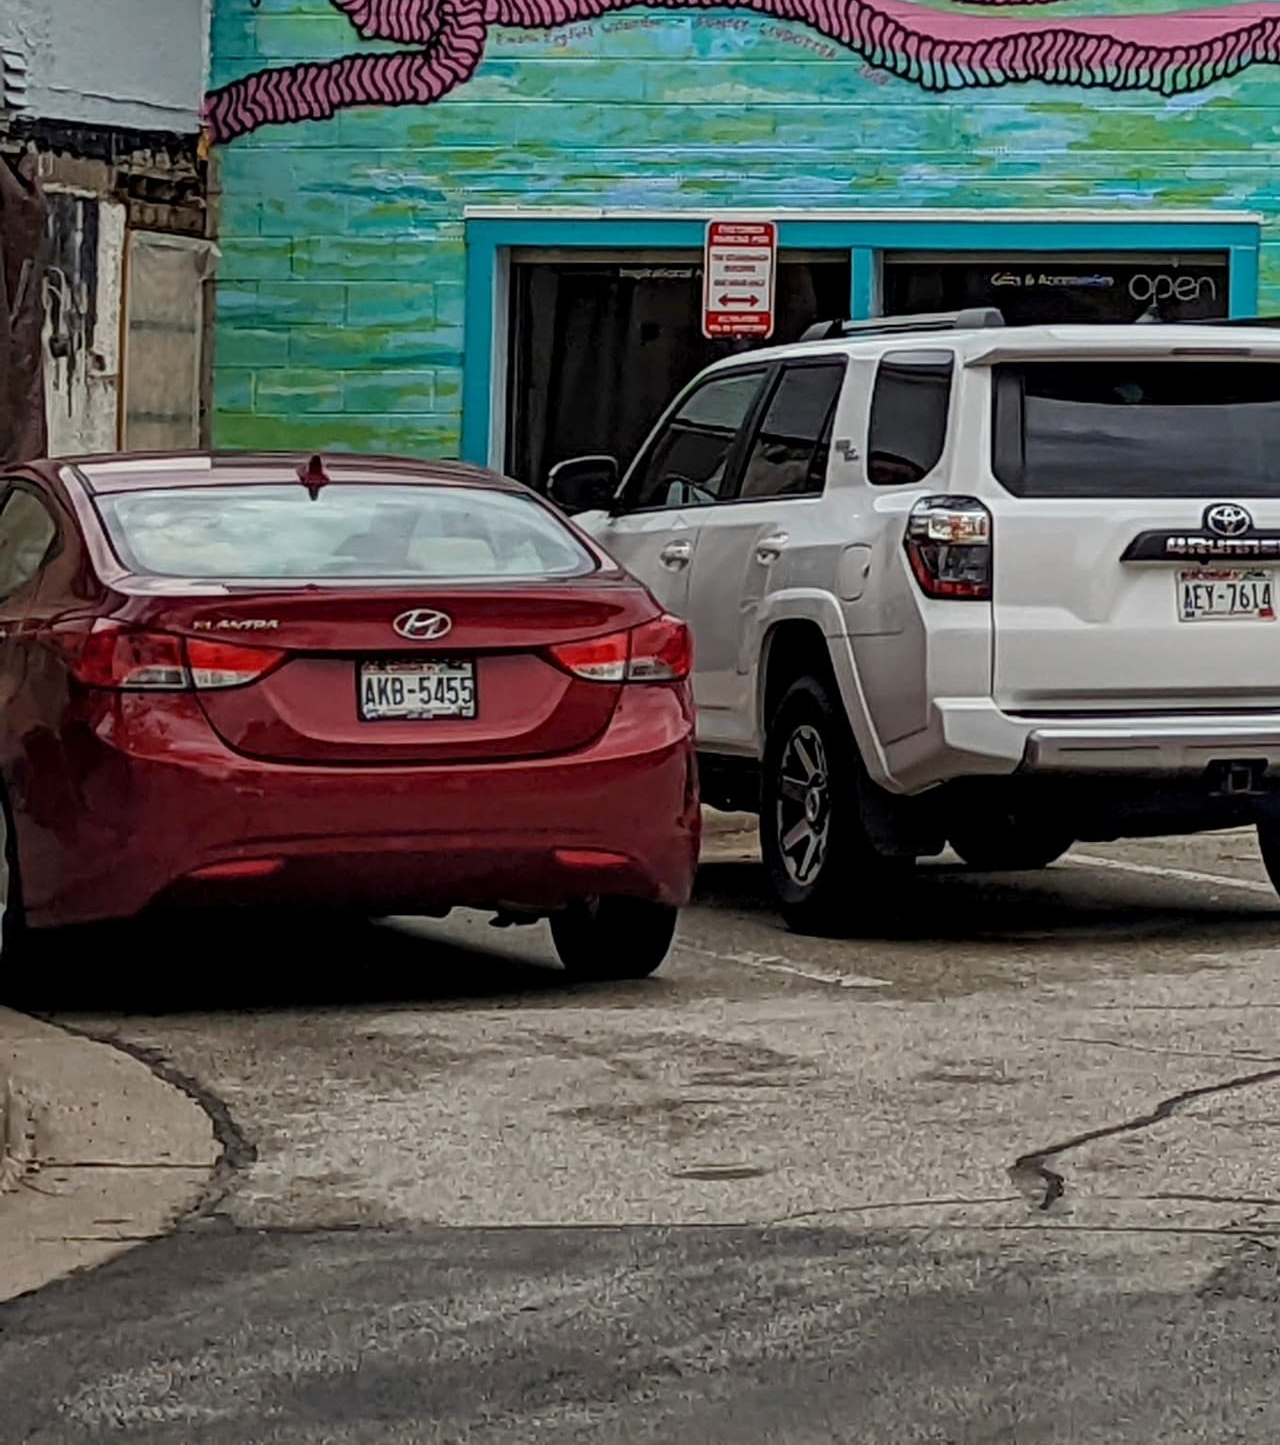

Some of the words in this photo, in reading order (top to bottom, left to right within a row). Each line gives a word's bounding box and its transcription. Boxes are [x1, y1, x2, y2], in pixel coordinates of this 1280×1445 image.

[1128, 273, 1217, 308] open
[1183, 583, 1273, 612] AEY-7614
[364, 675, 474, 706] AKB-5455
